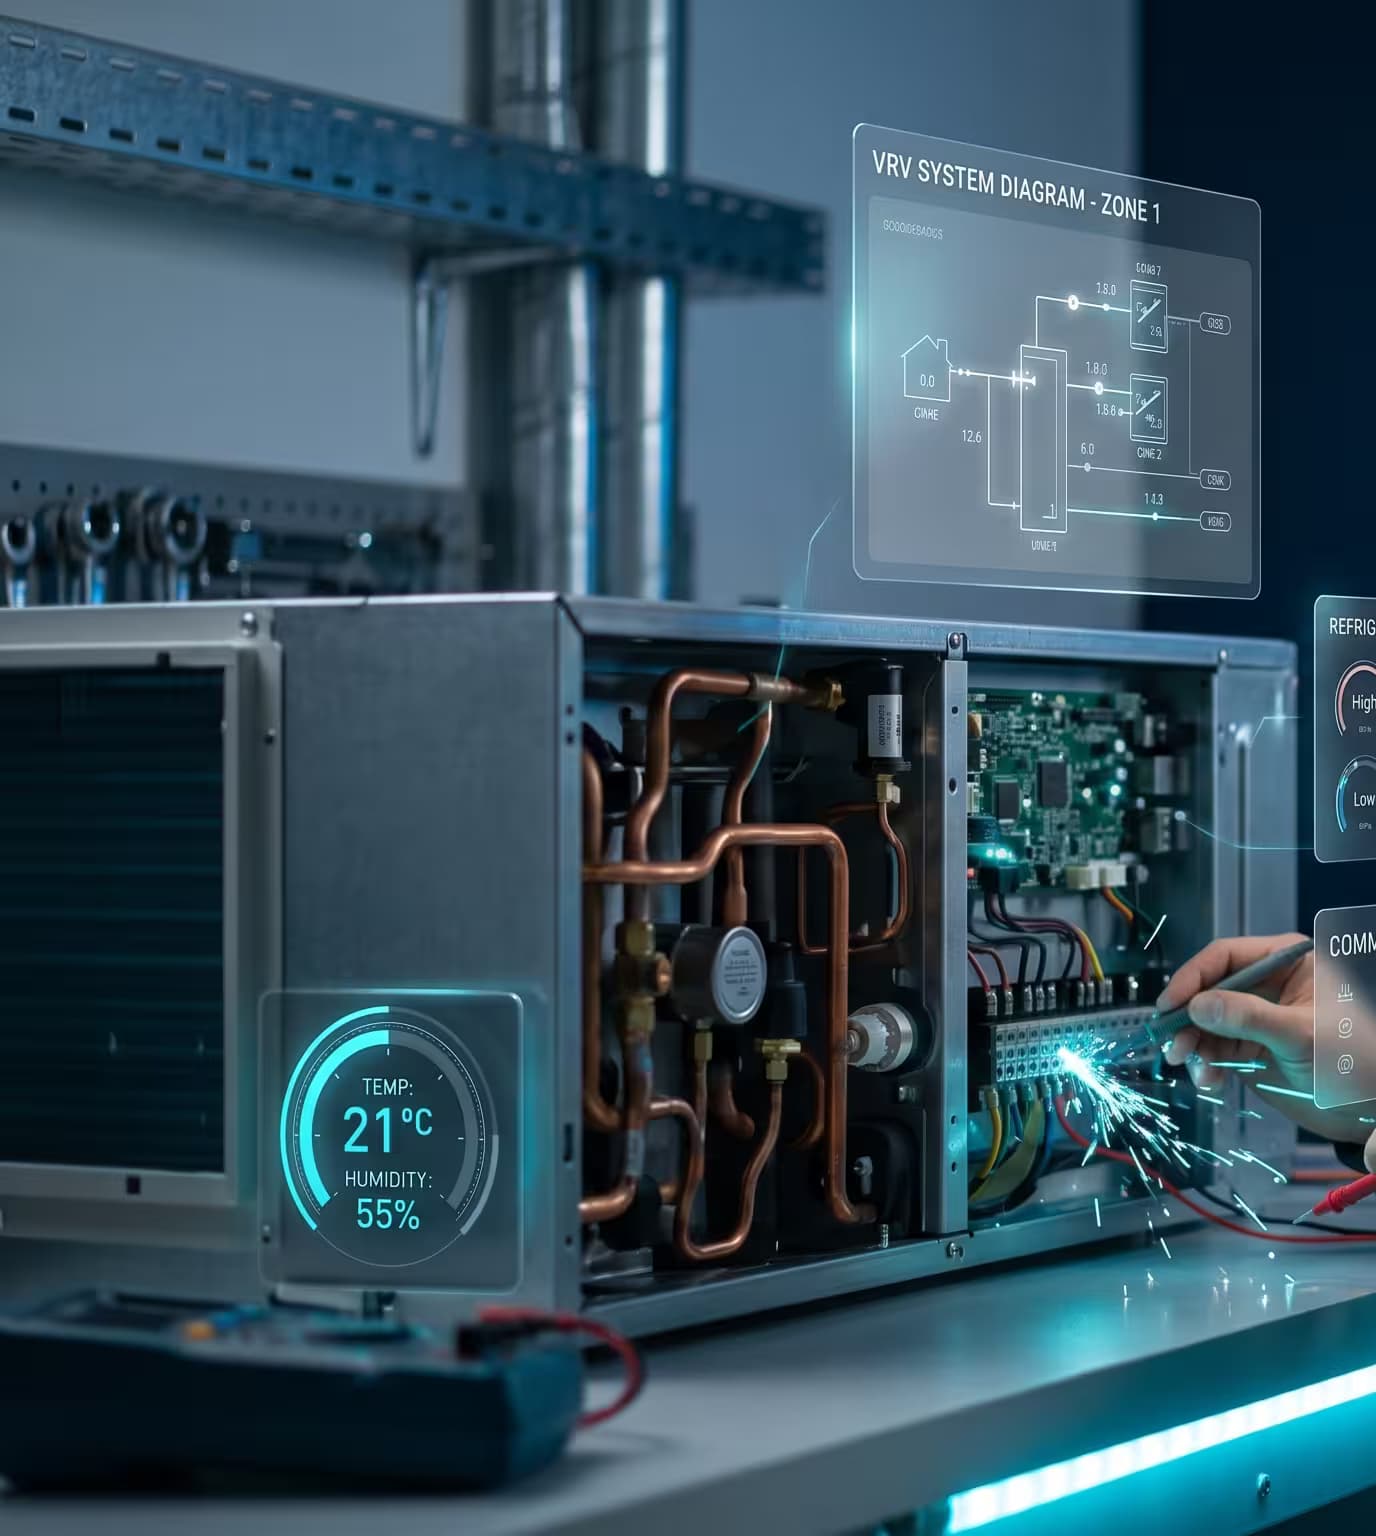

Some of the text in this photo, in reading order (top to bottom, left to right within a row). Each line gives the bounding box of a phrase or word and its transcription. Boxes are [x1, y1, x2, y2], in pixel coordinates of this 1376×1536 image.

[872, 149, 913, 179] VRV
[918, 160, 994, 195] SYSTEM
[1001, 174, 1085, 211] DIAGRAM
[1101, 192, 1148, 223] ZONE
[1152, 203, 1161, 224] 1
[962, 429, 982, 443] 12.6
[1080, 443, 1095, 455] 6.0
[1354, 792, 1376, 807] Low
[362, 1077, 414, 1096] TEMP:
[345, 1171, 433, 1189] HUMIDITY:
[357, 1198, 420, 1230] 55%
